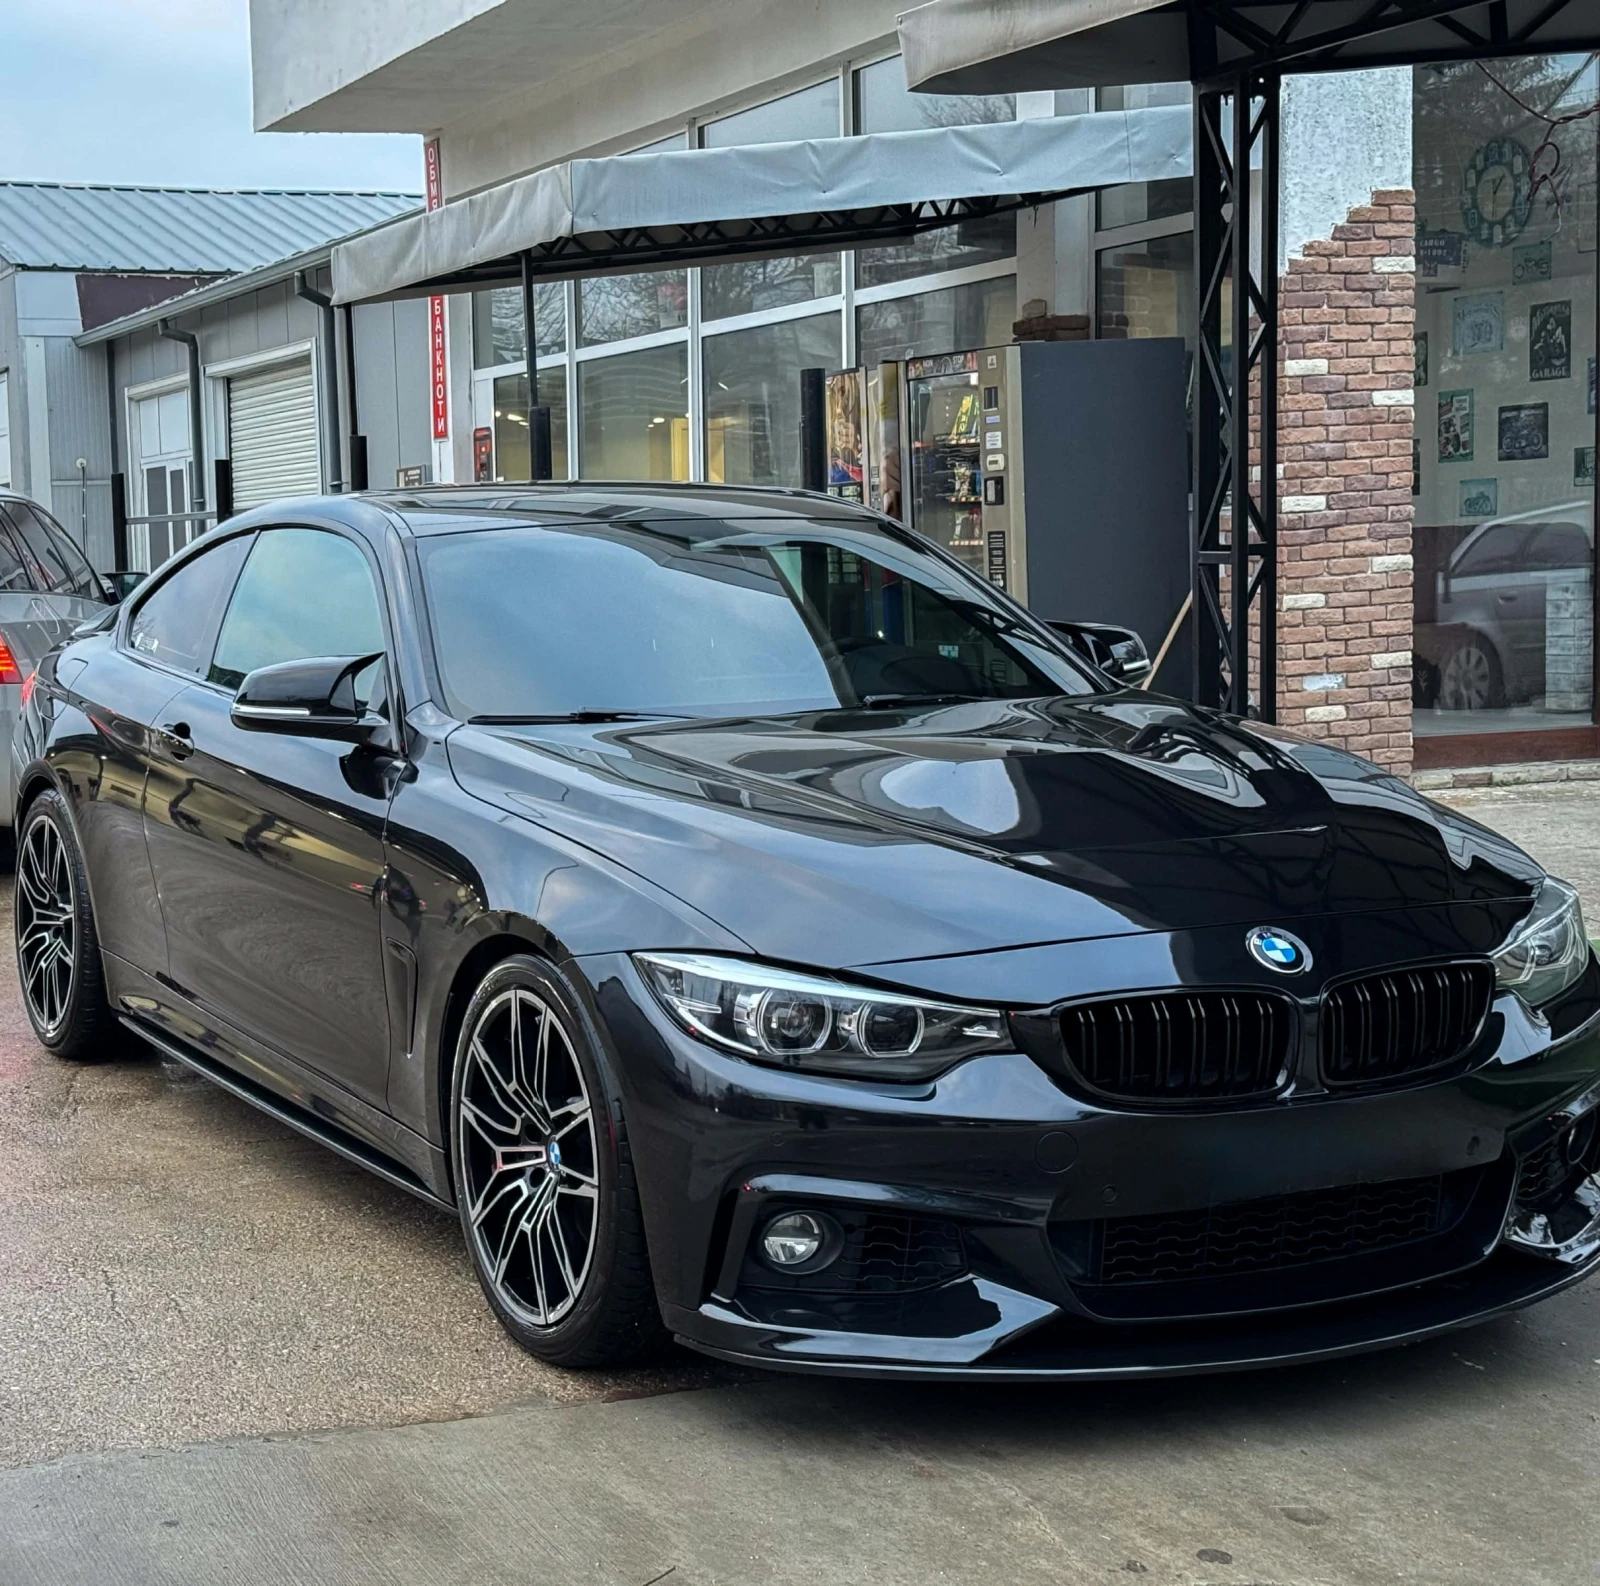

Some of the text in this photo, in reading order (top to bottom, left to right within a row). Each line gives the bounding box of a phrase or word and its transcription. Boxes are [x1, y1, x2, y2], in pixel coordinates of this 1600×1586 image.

[434, 299, 445, 433] БАНКНОТИ
[952, 355, 965, 365] STOP
[1532, 366, 1568, 379] GARAGE
